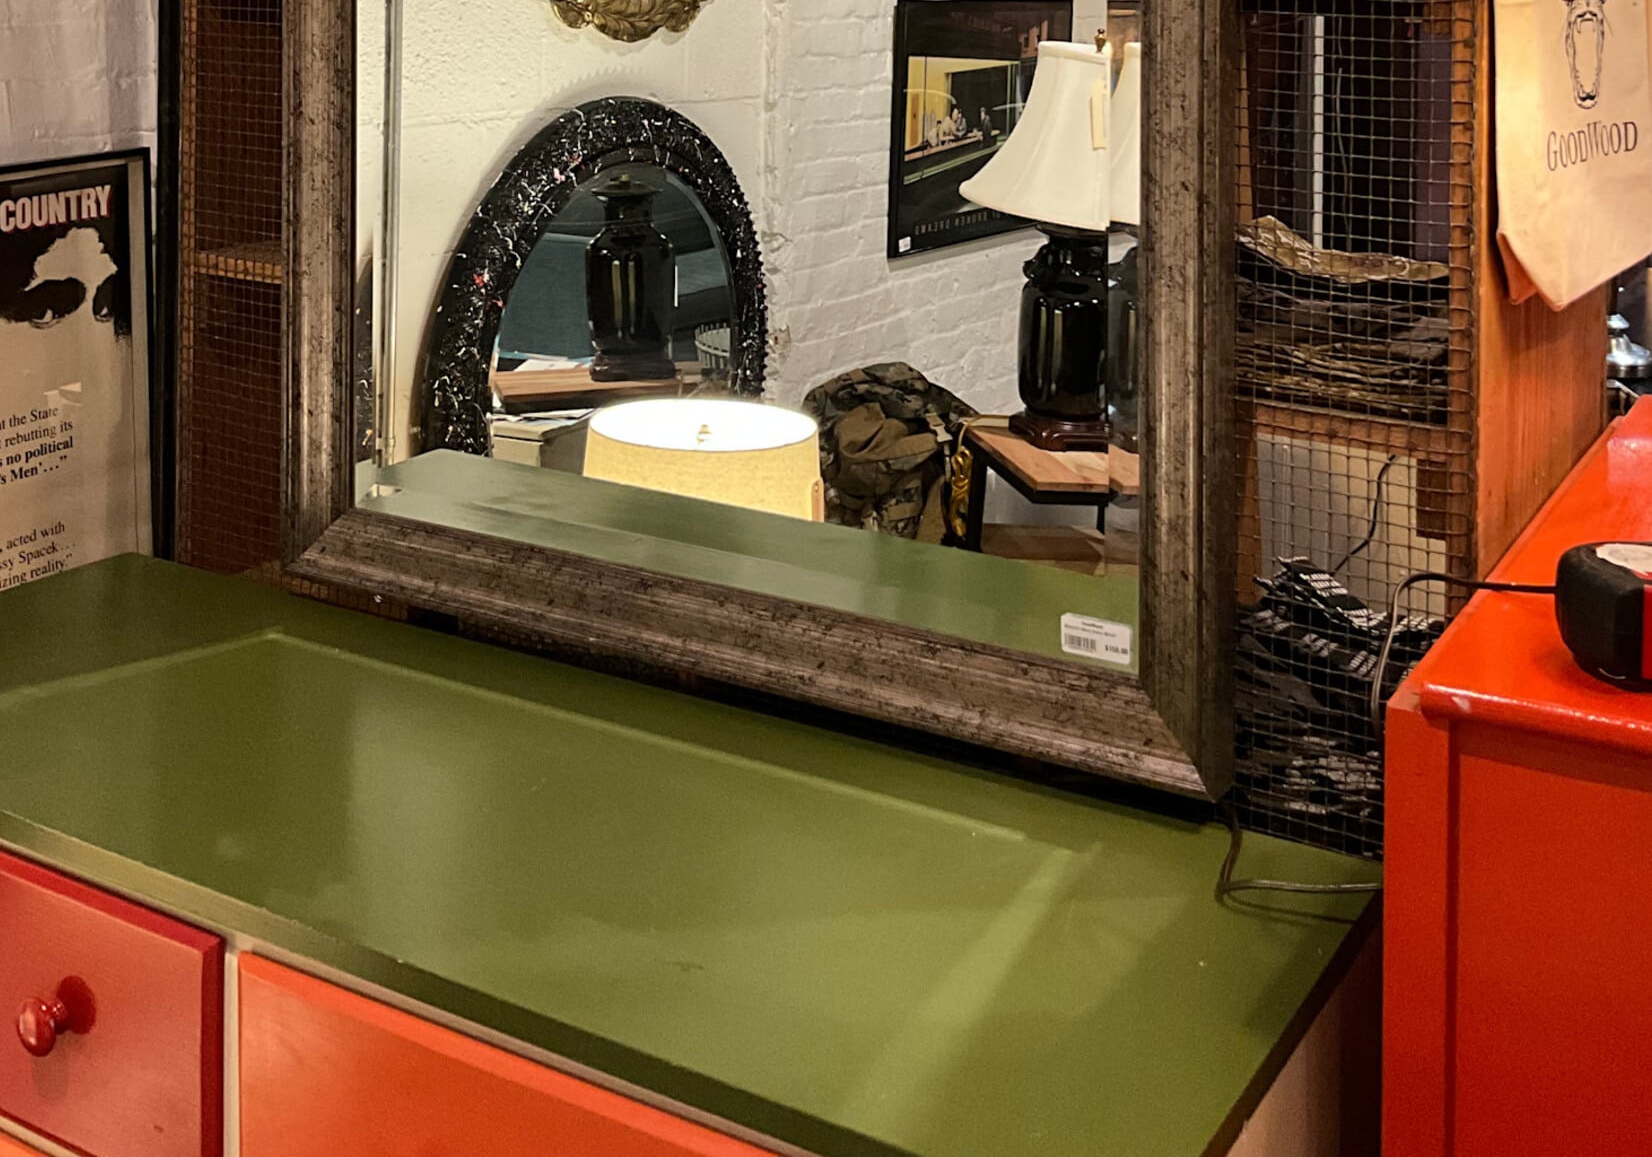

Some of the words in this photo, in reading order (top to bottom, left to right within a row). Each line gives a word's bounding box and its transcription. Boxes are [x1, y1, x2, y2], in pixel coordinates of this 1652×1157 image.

[0, 184, 112, 233] COUNTRY
[9, 414, 27, 428] the
[30, 407, 59, 423] State
[5, 425, 57, 447] rebutting
[60, 420, 73, 433] its
[6, 452, 21, 465] no
[25, 435, 73, 463] political
[6, 528, 37, 550] acted
[40, 521, 65, 538] with
